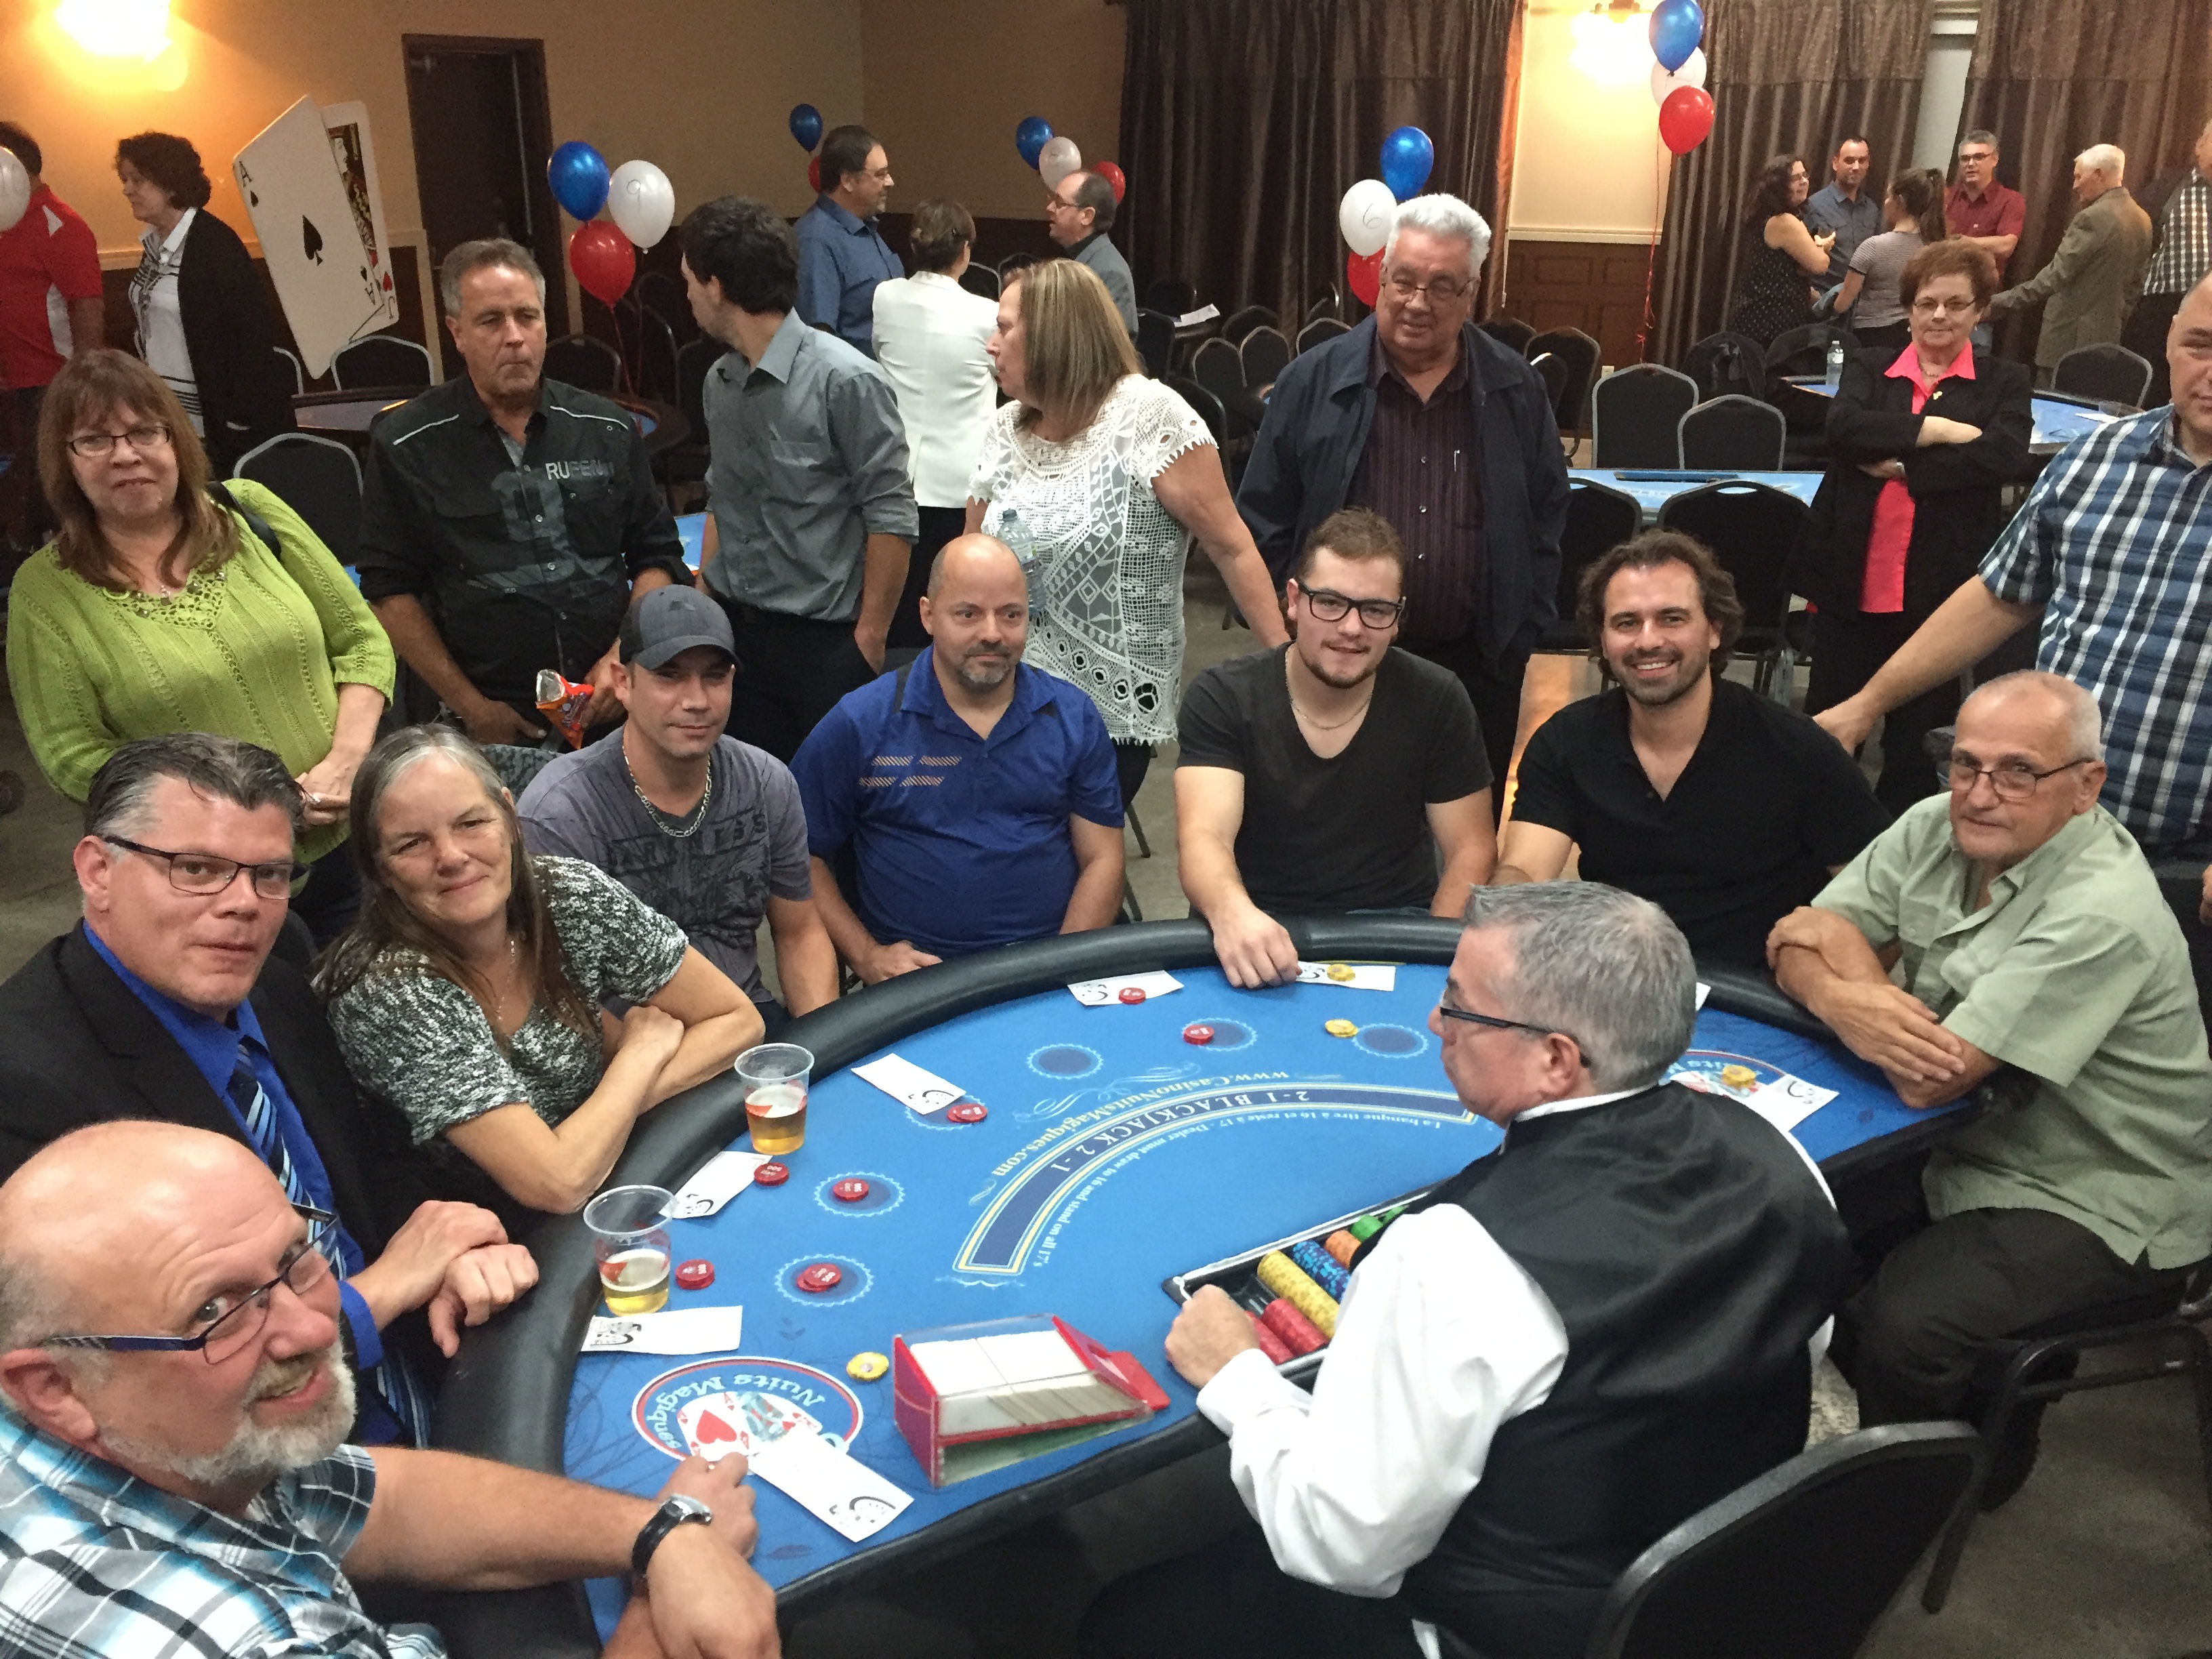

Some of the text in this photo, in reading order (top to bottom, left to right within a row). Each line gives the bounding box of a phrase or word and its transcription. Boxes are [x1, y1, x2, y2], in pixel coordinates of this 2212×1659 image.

[238, 160, 253, 188] A
[1362, 203, 1382, 229] 6
[363, 282, 376, 306] A
[991, 1071, 1289, 1176] www.CasinoNuitsMagiques.com
[1094, 1094, 1252, 1146] BLACKJACK
[1168, 1124, 1209, 1141] Dealer
[1138, 1138, 1166, 1153] must
[1113, 1152, 1141, 1168] draw
[1103, 1168, 1117, 1176] to
[1091, 1176, 1107, 1186] 16
[1076, 1185, 1094, 1202] and
[1057, 1200, 1080, 1224] stand
[1049, 1223, 1062, 1235] on
[1042, 1236, 1057, 1249] all
[646, 1374, 825, 1449] Nuits Magiques
